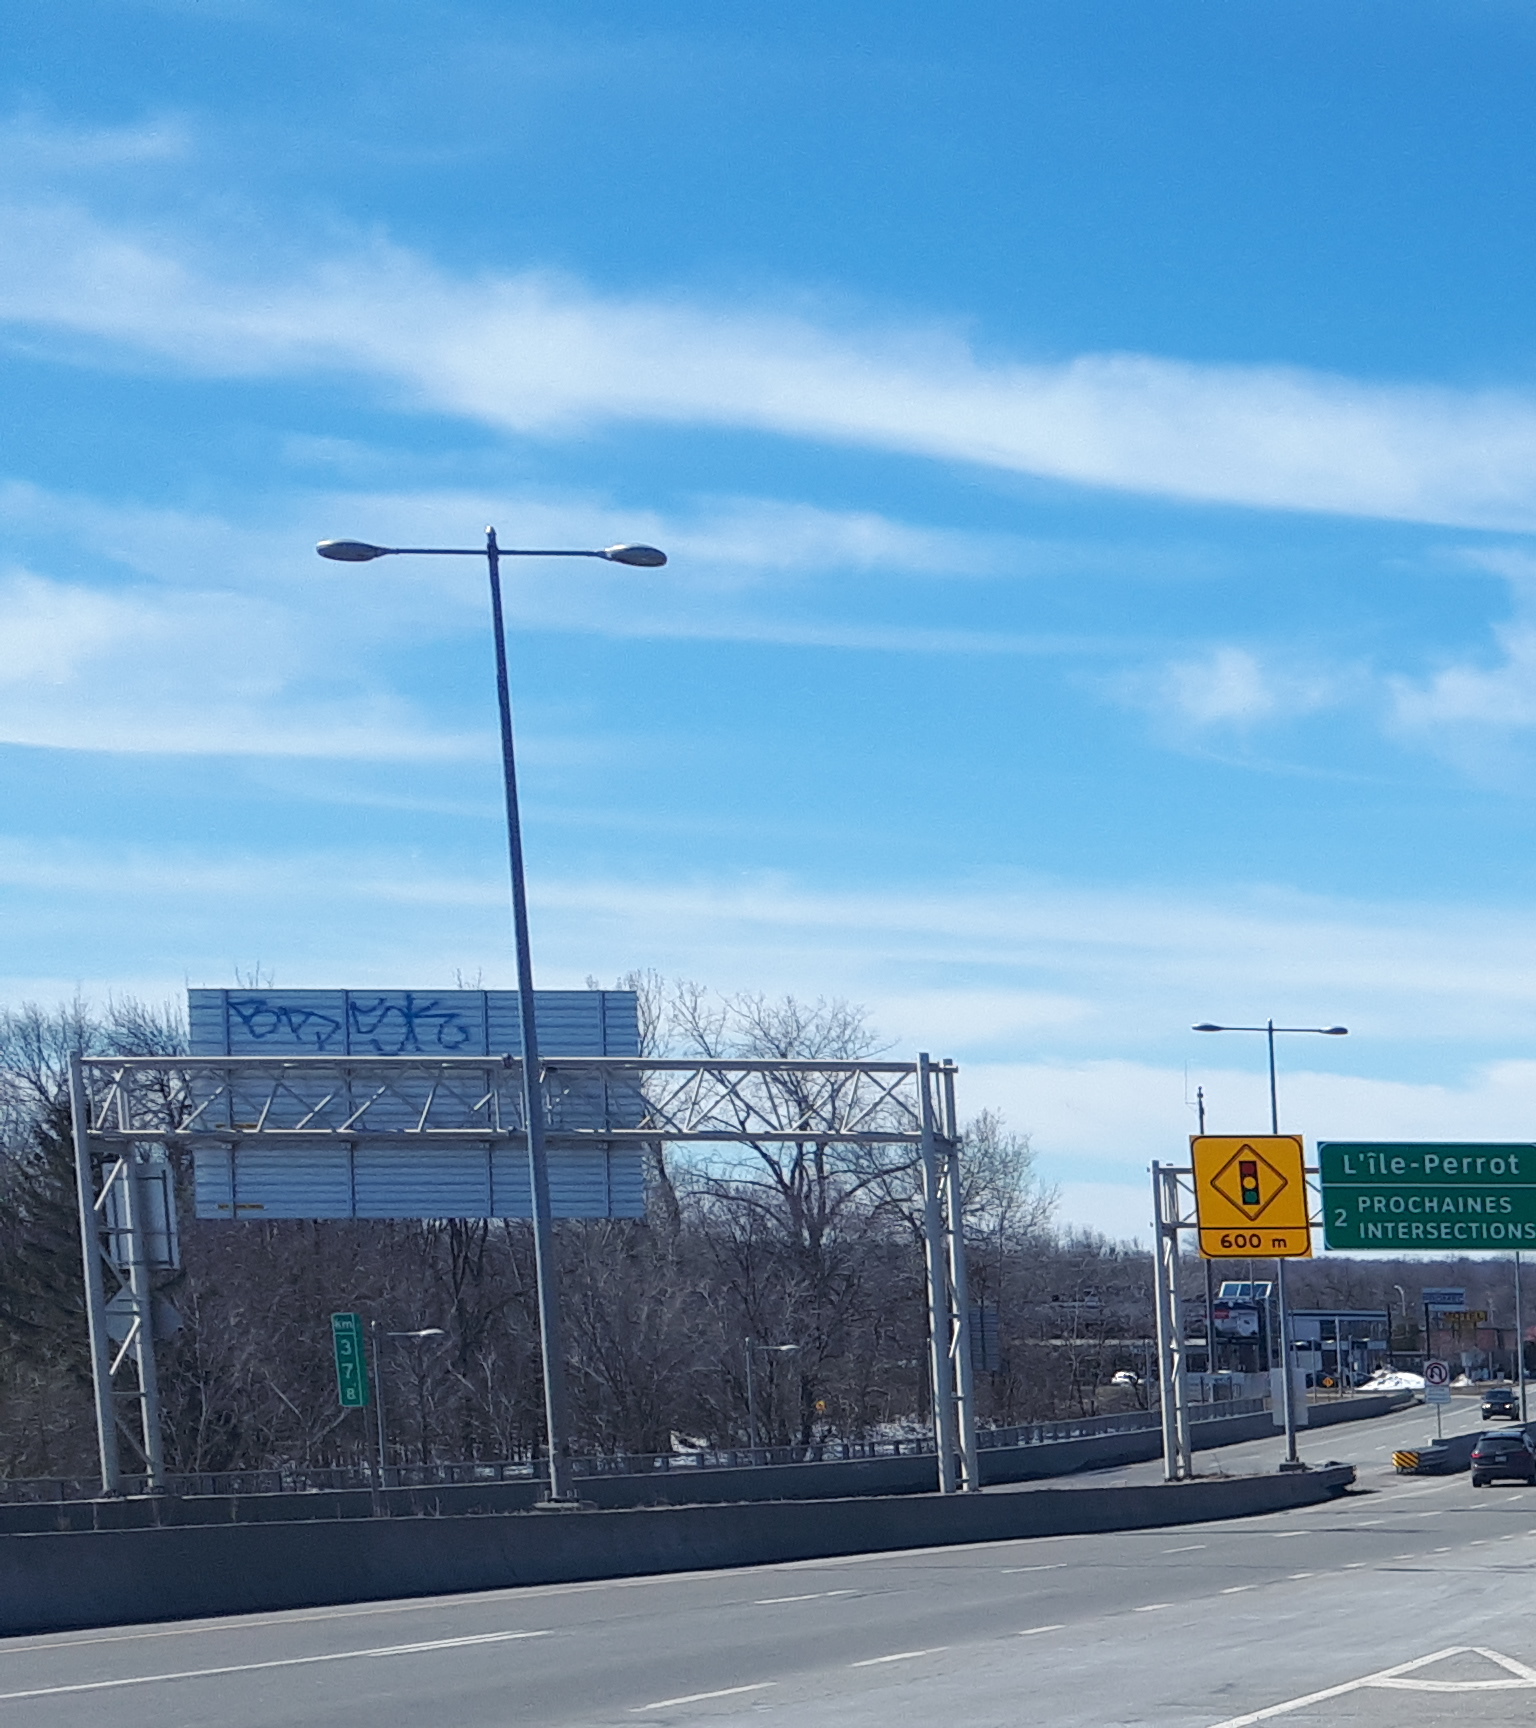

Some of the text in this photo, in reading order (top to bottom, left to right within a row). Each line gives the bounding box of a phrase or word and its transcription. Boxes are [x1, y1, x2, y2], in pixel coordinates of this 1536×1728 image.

[1343, 1153, 1520, 1175] L'île-Perrot
[1357, 1196, 1512, 1214] PROCHAINES
[1334, 1209, 1348, 1228] 2
[1359, 1222, 1536, 1240] INTERSECTIONS
[1220, 1233, 1287, 1249] 600 m
[340, 1339, 352, 1355] 3
[341, 1362, 354, 1379] 7
